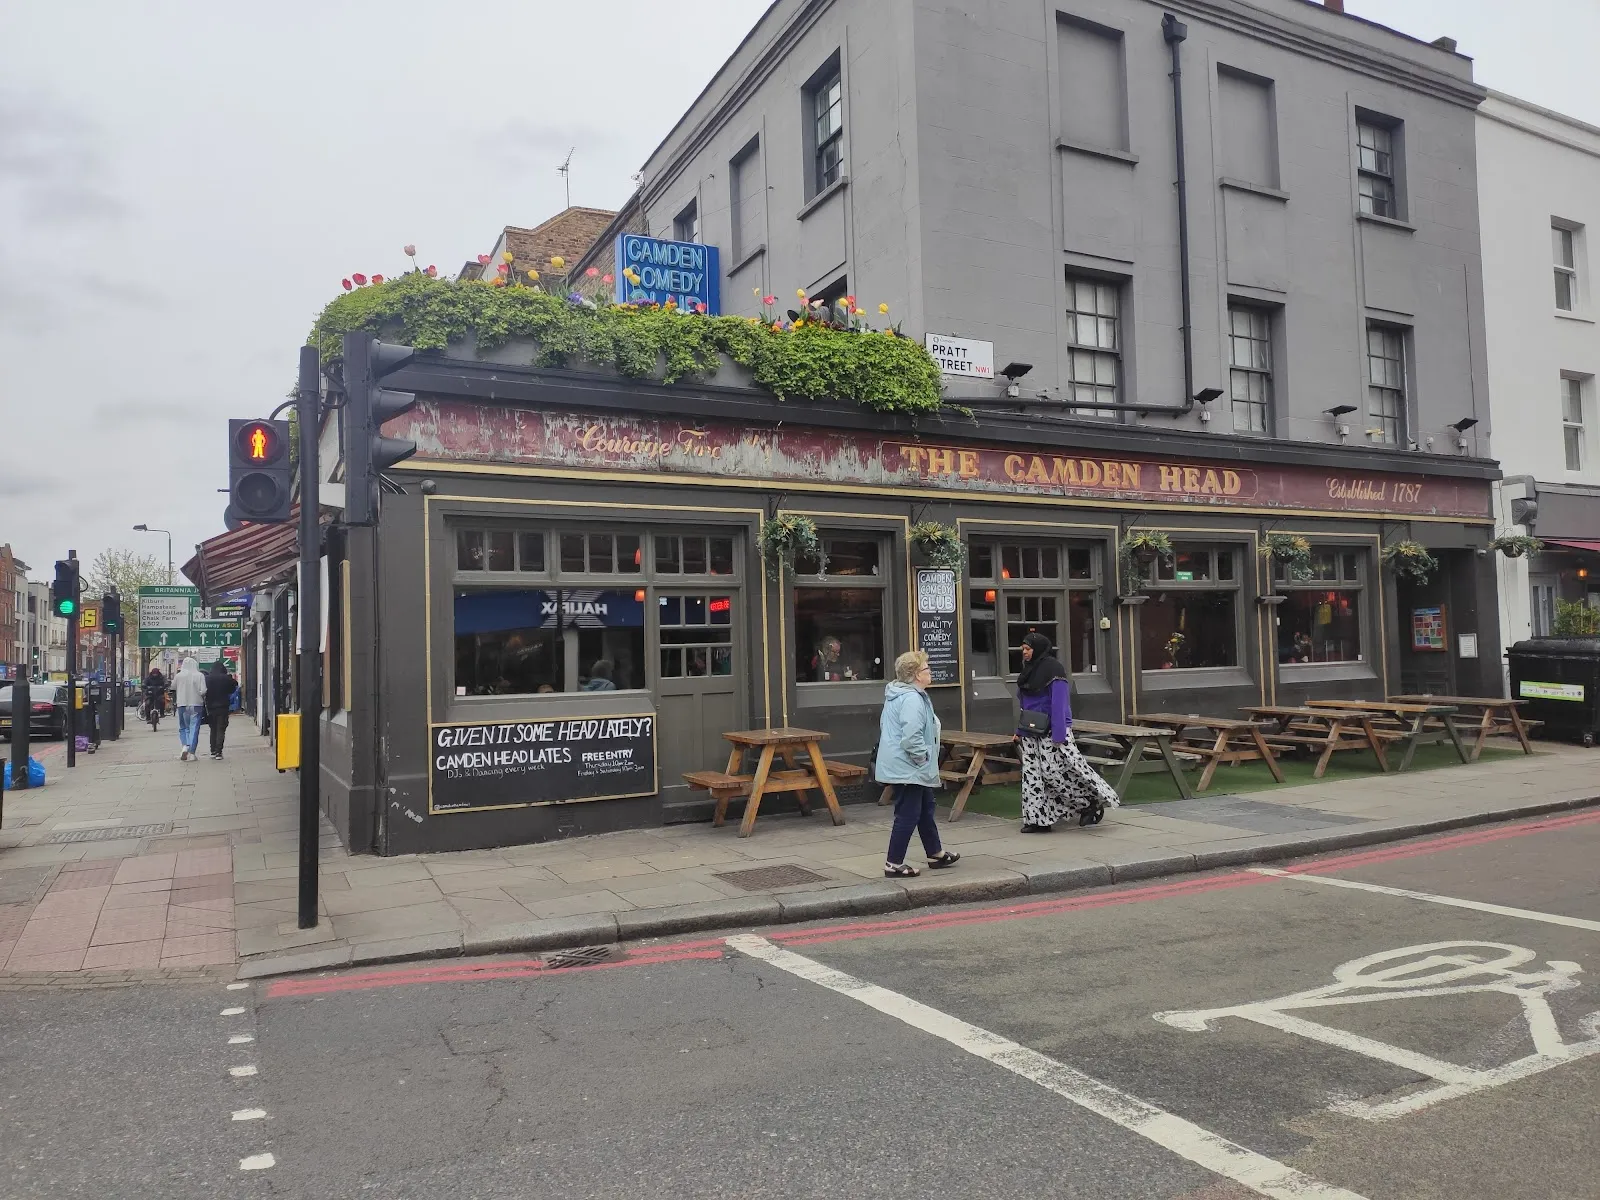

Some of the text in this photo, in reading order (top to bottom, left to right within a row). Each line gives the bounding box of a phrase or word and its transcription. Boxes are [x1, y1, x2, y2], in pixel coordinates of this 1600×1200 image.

[627, 239, 703, 270] CAMDEN
[628, 264, 703, 294] COMEDY
[932, 344, 967, 358] PRATT
[575, 425, 672, 460] Courage
[900, 446, 1242, 495] THE CAMDEN HEAD
[1326, 477, 1423, 503] Established 1787
[920, 573, 952, 583] CAMDEN
[920, 585, 952, 595] COMEDY
[920, 596, 953, 610] CLUB
[921, 621, 953, 629] QUALITY
[923, 633, 952, 642] COMEDY
[437, 717, 652, 748] GIVEN IT SOME HEAD LATELY?
[436, 747, 572, 770] CAMDEN HEAD LATES
[581, 748, 634, 762] FREE ENTRY
[447, 763, 546, 779] DJs & Dancing every week
[584, 761, 612, 769] Thursday
